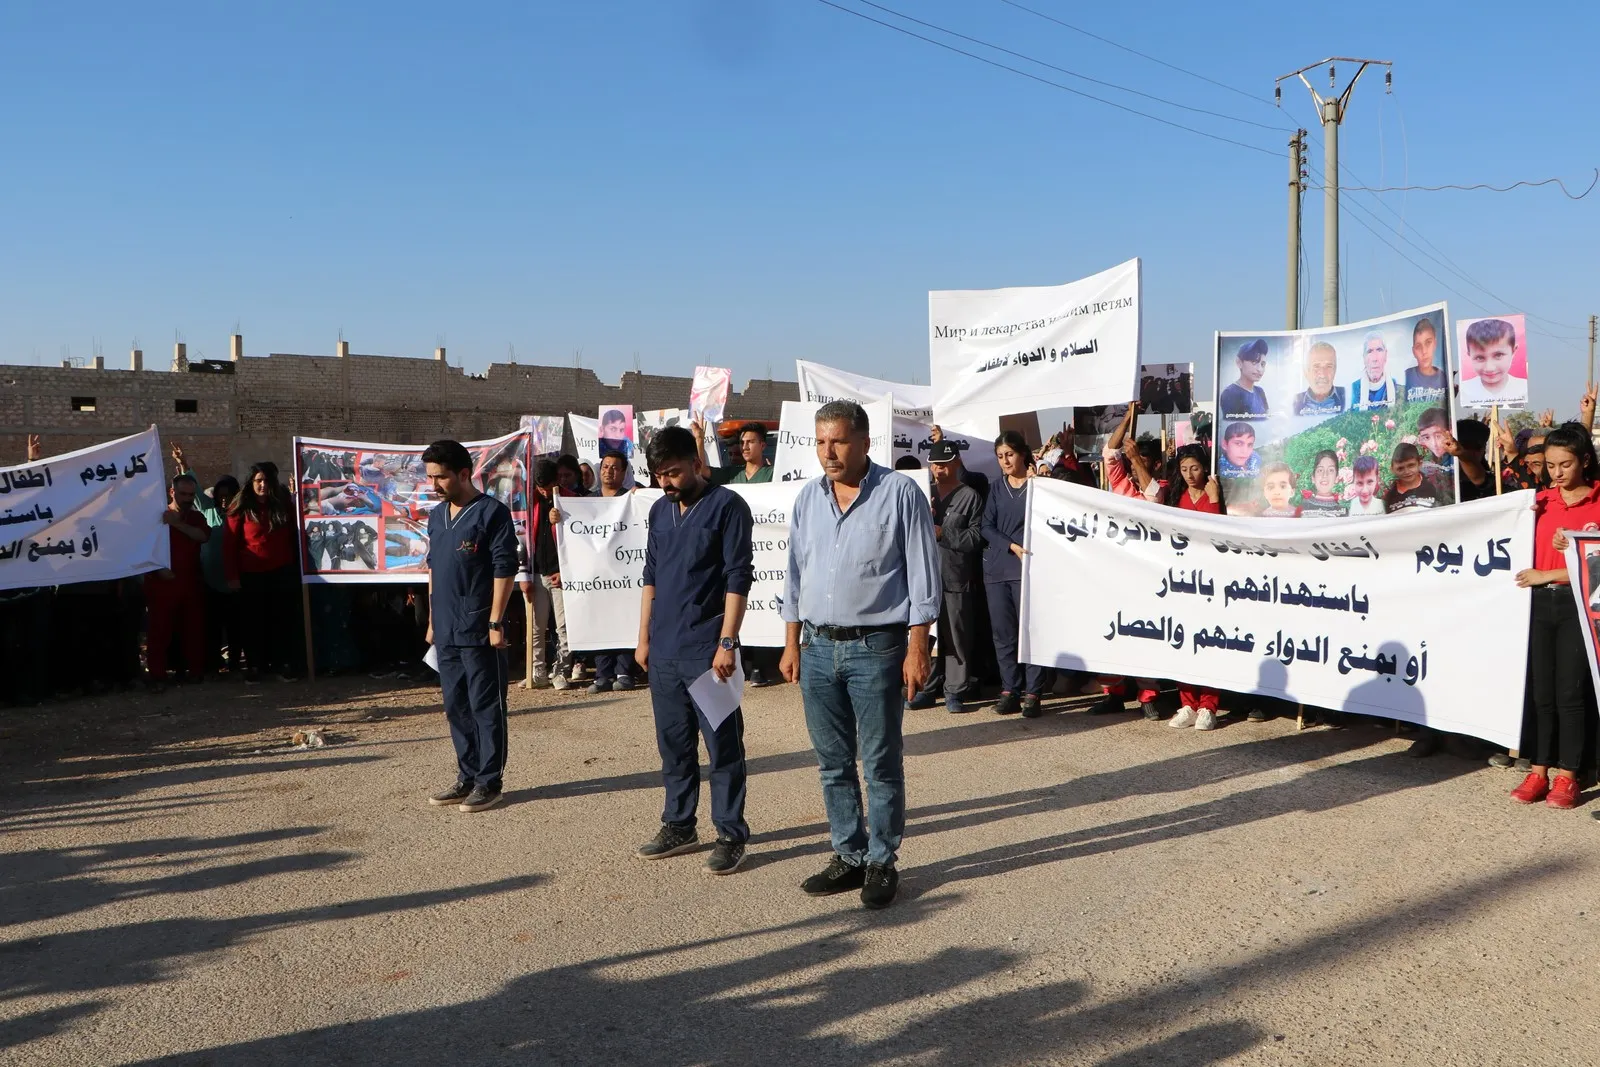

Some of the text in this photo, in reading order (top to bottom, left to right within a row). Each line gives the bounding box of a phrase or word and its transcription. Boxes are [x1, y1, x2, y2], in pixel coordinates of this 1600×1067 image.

[934, 325, 967, 341] Мир
[980, 320, 1046, 337] лекарства
[1092, 296, 1133, 315] детям
[1012, 346, 1046, 366] الدواء
[1060, 338, 1098, 362] السلام
[893, 408, 919, 417] вает
[576, 438, 597, 450] Мир
[779, 430, 816, 449] Пуст
[893, 433, 913, 453] يقت
[79, 461, 118, 486] يوم
[124, 453, 148, 479] كل
[0, 503, 54, 527] باست
[1046, 512, 1098, 542] الموت
[570, 520, 628, 538] Смерть
[0, 525, 100, 562] أو بمنع الد
[615, 545, 648, 565] буд
[752, 539, 773, 552] ате
[1311, 535, 1380, 561] أطفال
[1415, 542, 1464, 575] يوم
[1473, 537, 1512, 577] كل
[563, 575, 632, 593] ждебной
[1155, 566, 1370, 621] باستهدافهم بالنار
[1103, 610, 1428, 686] أو بمنع الدواء عنهم والحصار
